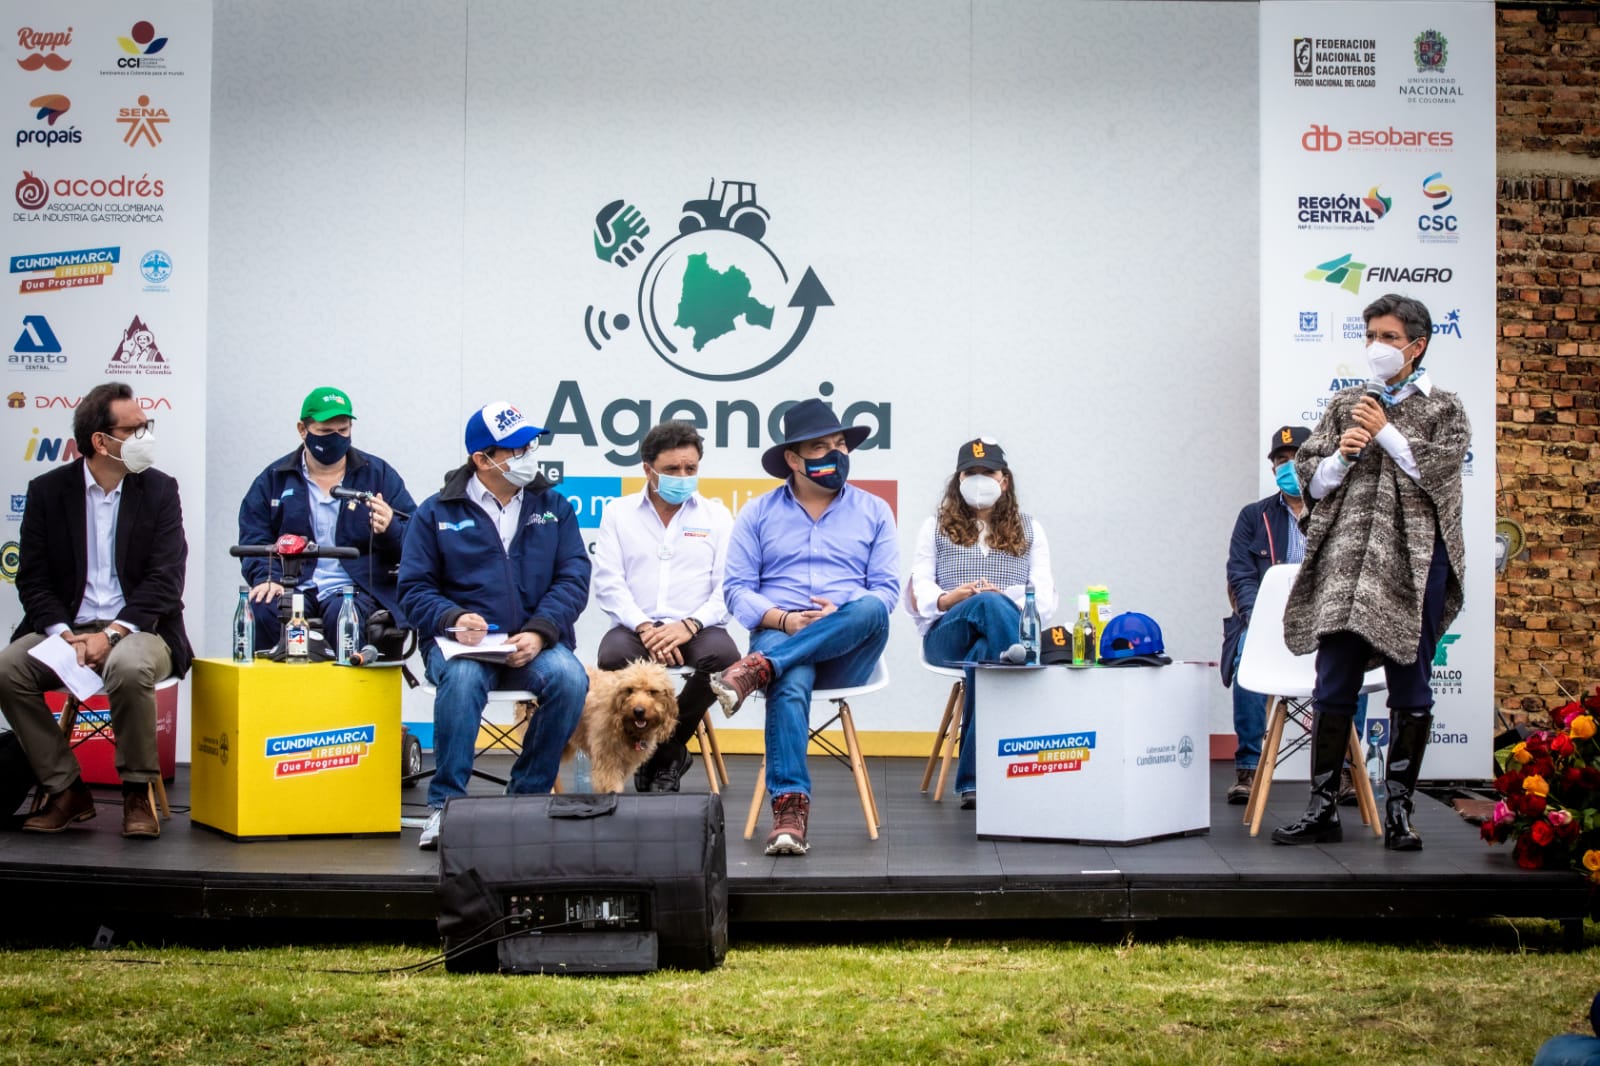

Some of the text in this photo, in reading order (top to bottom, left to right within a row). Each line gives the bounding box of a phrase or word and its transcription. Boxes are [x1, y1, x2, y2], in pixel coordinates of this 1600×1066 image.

[17, 26, 73, 51] Rappi
[1315, 39, 1376, 50] FEDERACION
[117, 57, 140, 69] CCI
[1315, 52, 1376, 63] NACIONAL DE
[1315, 65, 1376, 76] CACAOTEROS
[1294, 78, 1376, 88] FONDO NACIONAL DEL CACAO
[1399, 86, 1464, 96] NACIONAL
[119, 108, 168, 117] SENA
[16, 126, 82, 148] propaís
[1347, 126, 1453, 147] asobares
[54, 173, 164, 197] acodrés
[47, 202, 164, 212] ASOCIACIÓN COLOMBIANA
[1298, 193, 1361, 209] REGIÓN
[13, 213, 163, 223] DE LA INDUSTRIA GASTRONÓMICA
[1298, 210, 1375, 223] CENTRAL
[1418, 215, 1458, 231] CSC
[16, 251, 114, 269] CUNDINAMARCA
[25, 275, 100, 290] Que Progresa!
[1366, 268, 1453, 283] FINAGRO
[8, 354, 67, 363] anato
[272, 731, 368, 752] CUNDINAMARCA
[1003, 736, 1090, 753] CUNDINAMARCA
[282, 755, 355, 772] Que Progresa!
[1011, 759, 1077, 773] Que Progresa!
